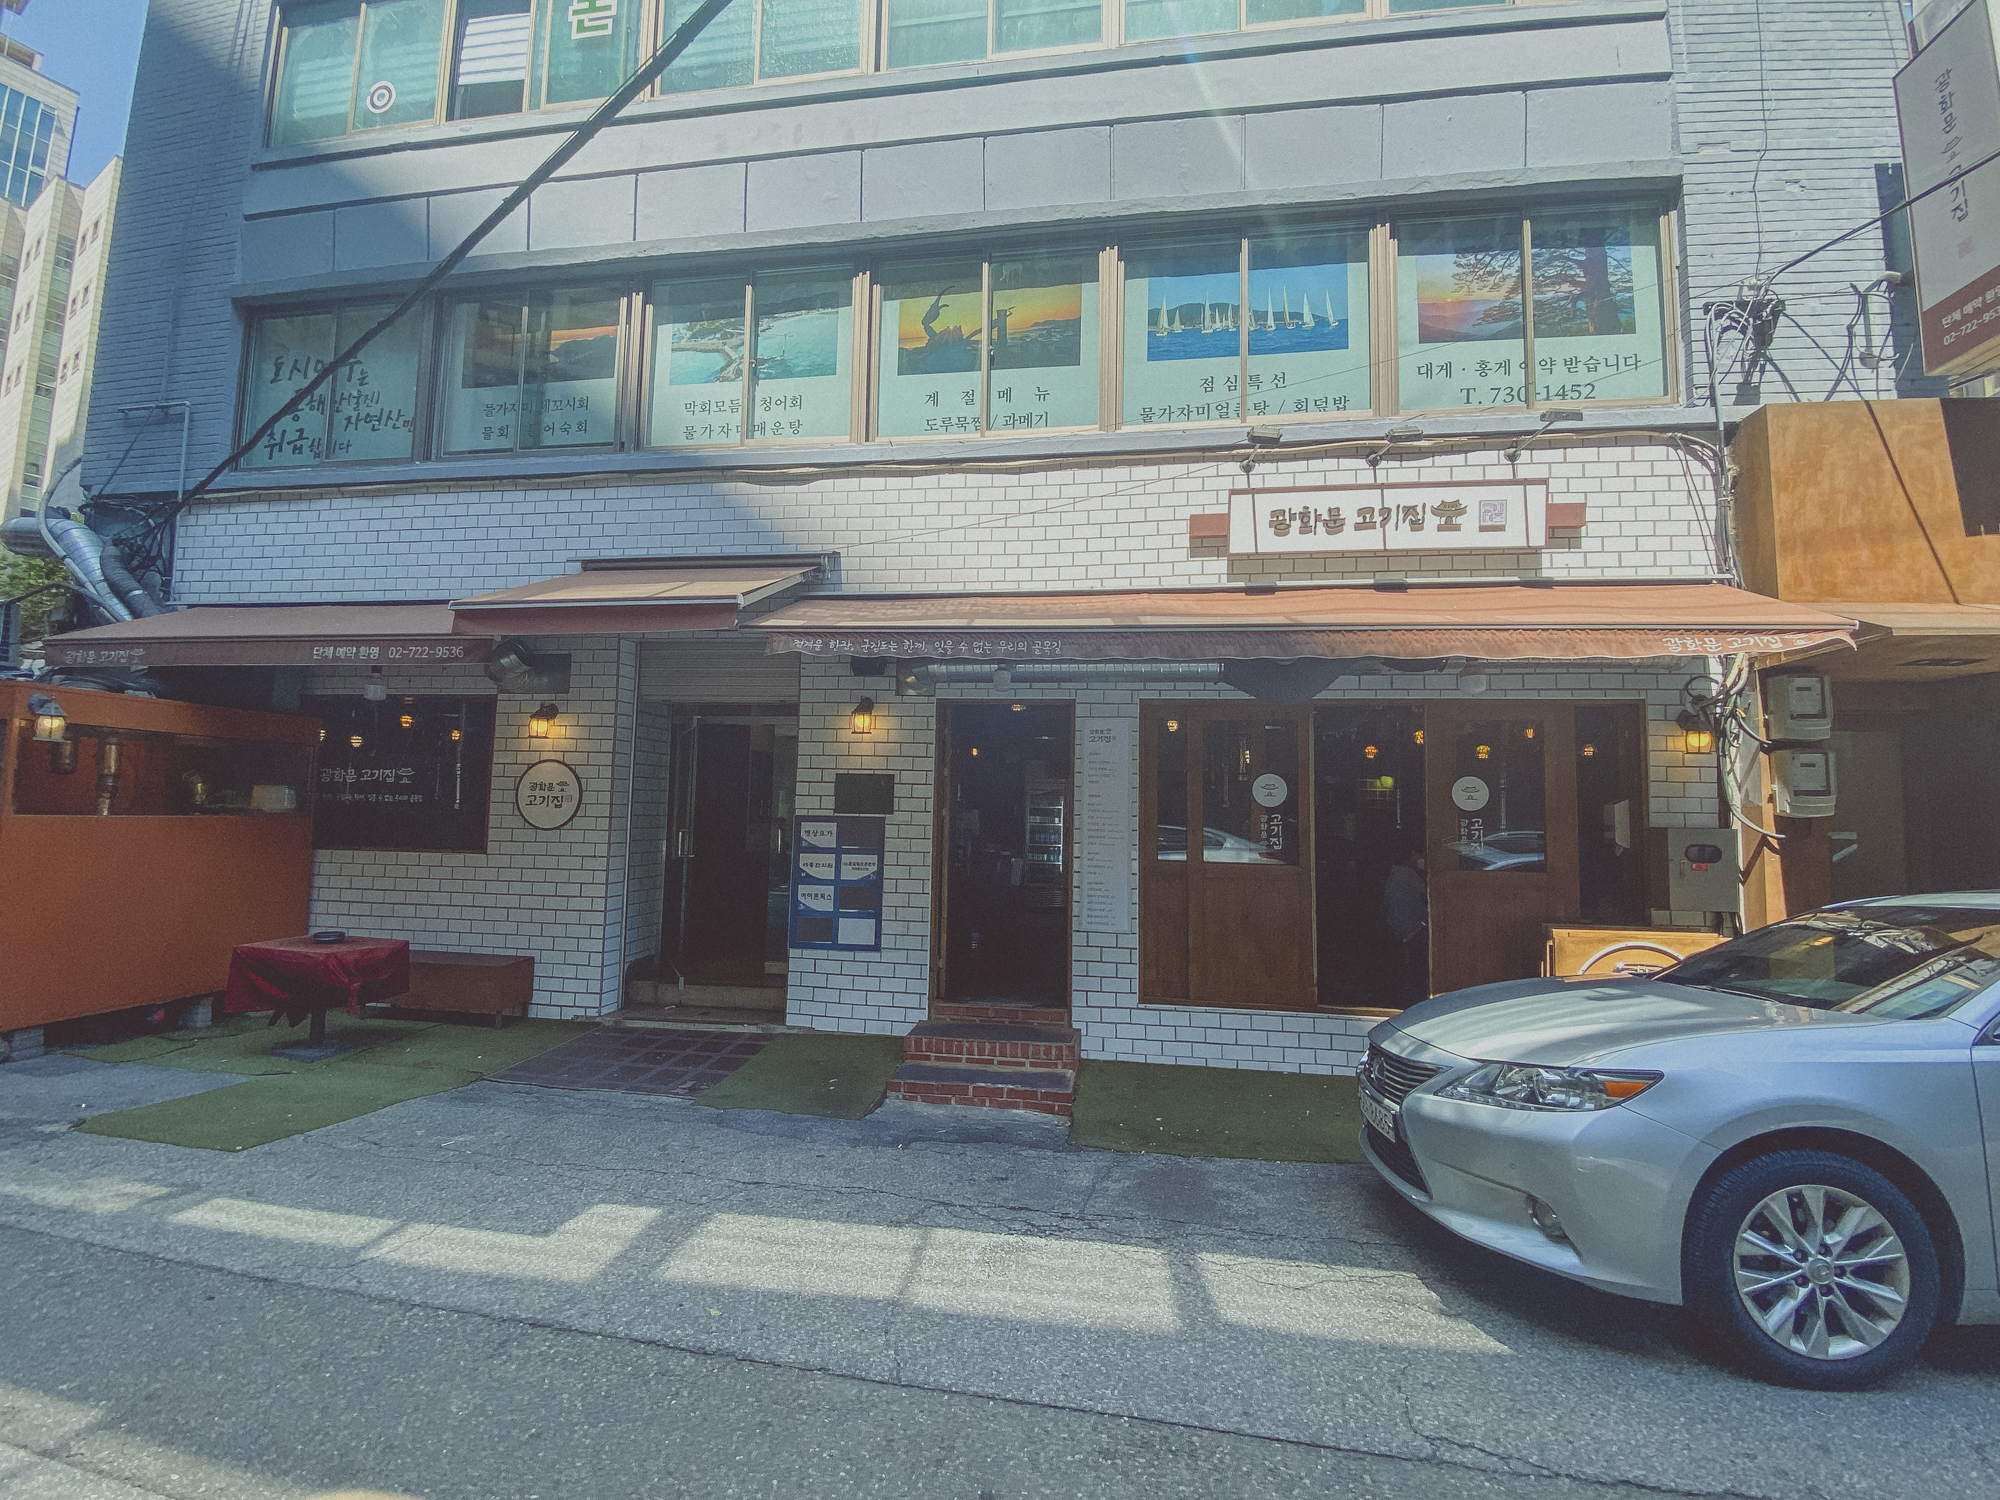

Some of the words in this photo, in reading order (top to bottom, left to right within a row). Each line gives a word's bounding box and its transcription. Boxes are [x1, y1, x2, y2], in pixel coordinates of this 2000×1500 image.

[1935, 68, 1957, 134] 광화문
[1942, 308, 1961, 329] 단체
[1963, 296, 1982, 314] 예약
[1563, 353, 1642, 373] 받습니다
[684, 398, 742, 416] 막회모듬
[759, 394, 803, 412] 청어회
[1294, 395, 1350, 413] 회덮밥
[1003, 411, 1049, 430] 과메기
[482, 425, 509, 440] 물회
[1268, 506, 1346, 537] 광화문
[1354, 502, 1427, 532] 고기집
[935, 640, 954, 655] 잊을
[958, 640, 968, 653] 수
[973, 640, 992, 653] 없는
[998, 640, 1027, 653] 우리의
[1032, 640, 1061, 655] 골목길
[1662, 637, 1722, 652] 광화문
[1727, 635, 1784, 649] 고기집
[313, 646, 334, 659] 단체
[336, 646, 356, 659] 예약
[359, 646, 379, 660] 환영
[388, 646, 464, 659] 02-722-9536
[320, 768, 357, 782] 광화문
[360, 768, 395, 782] 고기집
[529, 781, 555, 792] 광화문
[525, 795, 564, 809] 고기집
[1270, 814, 1282, 850] 고기집
